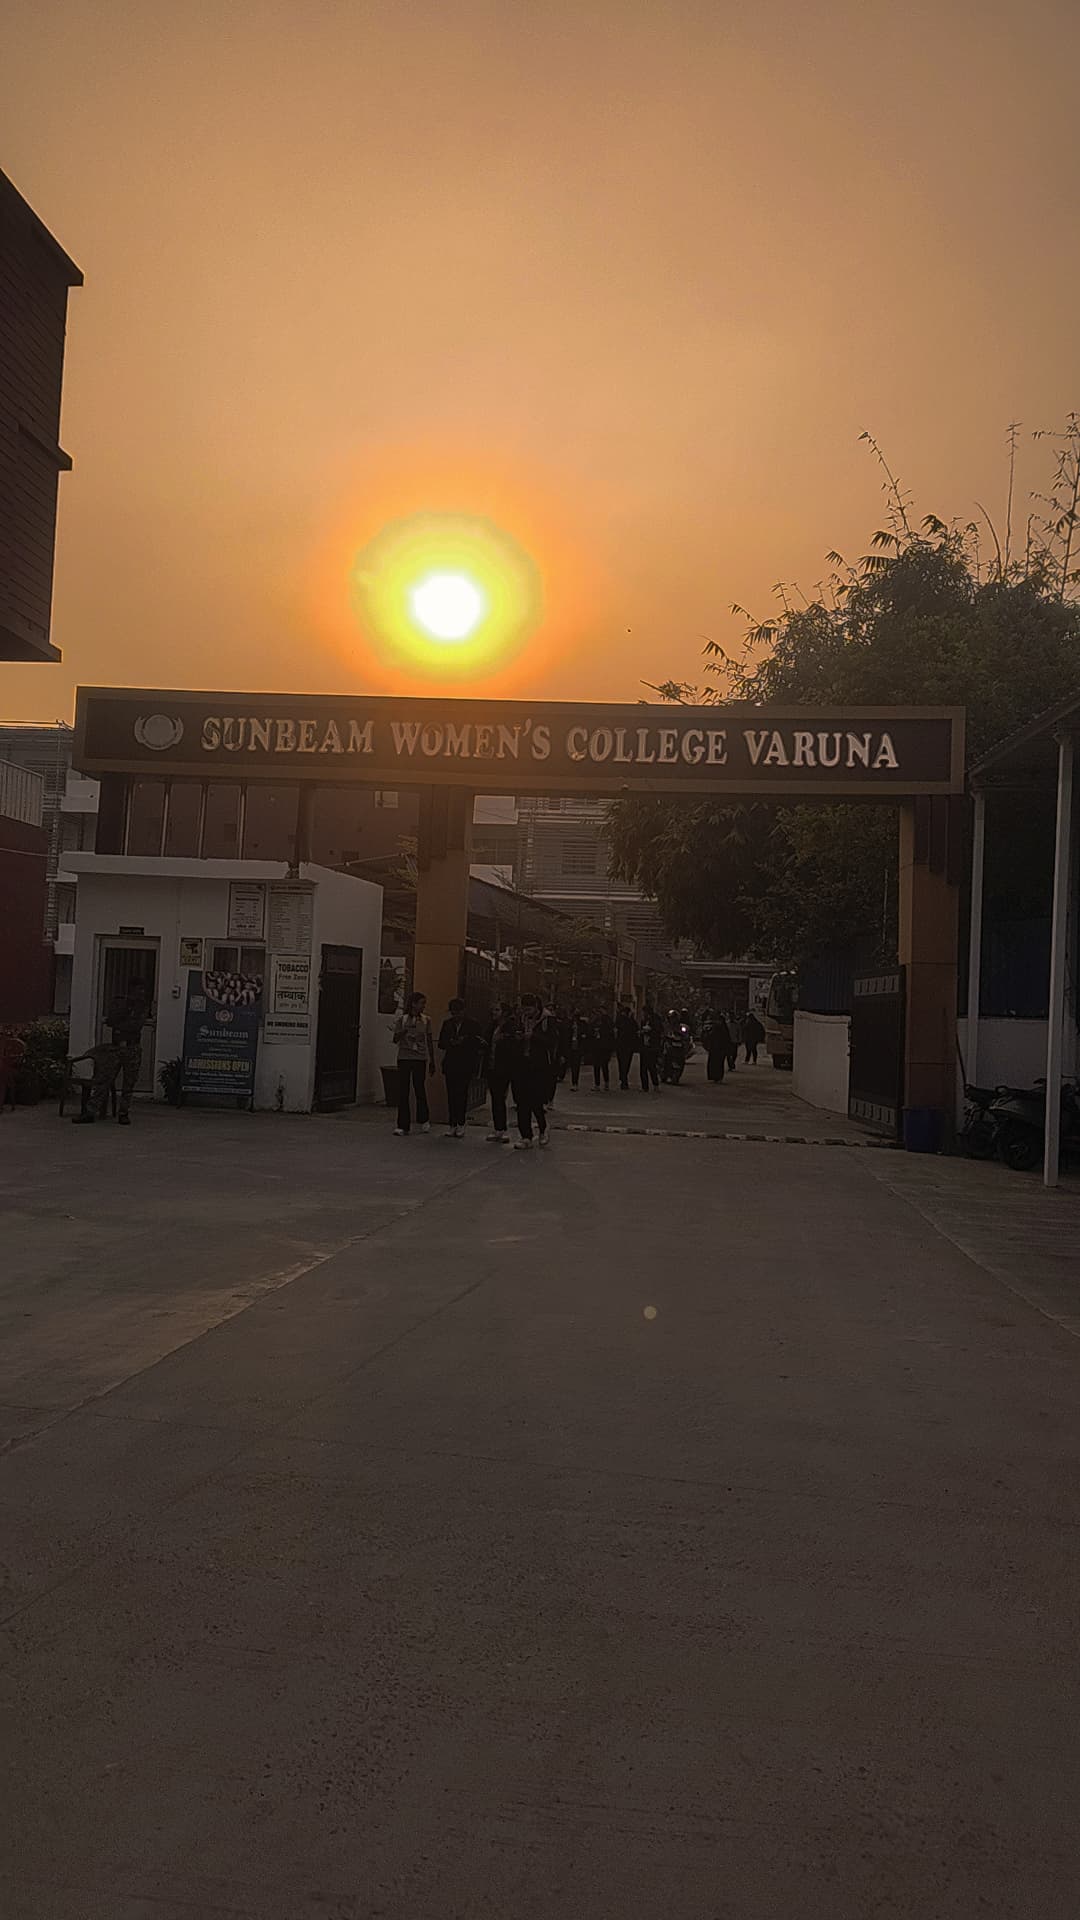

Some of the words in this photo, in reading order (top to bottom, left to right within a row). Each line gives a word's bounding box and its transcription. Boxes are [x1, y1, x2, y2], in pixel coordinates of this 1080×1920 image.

[201, 716, 375, 753] SUNBEAM
[390, 718, 551, 761] WOMEN'S
[567, 726, 728, 766] COLLEGE
[743, 730, 900, 769] VARUNA
[278, 963, 309, 973] TOBACCO
[199, 1025, 249, 1039] Sunbeam
